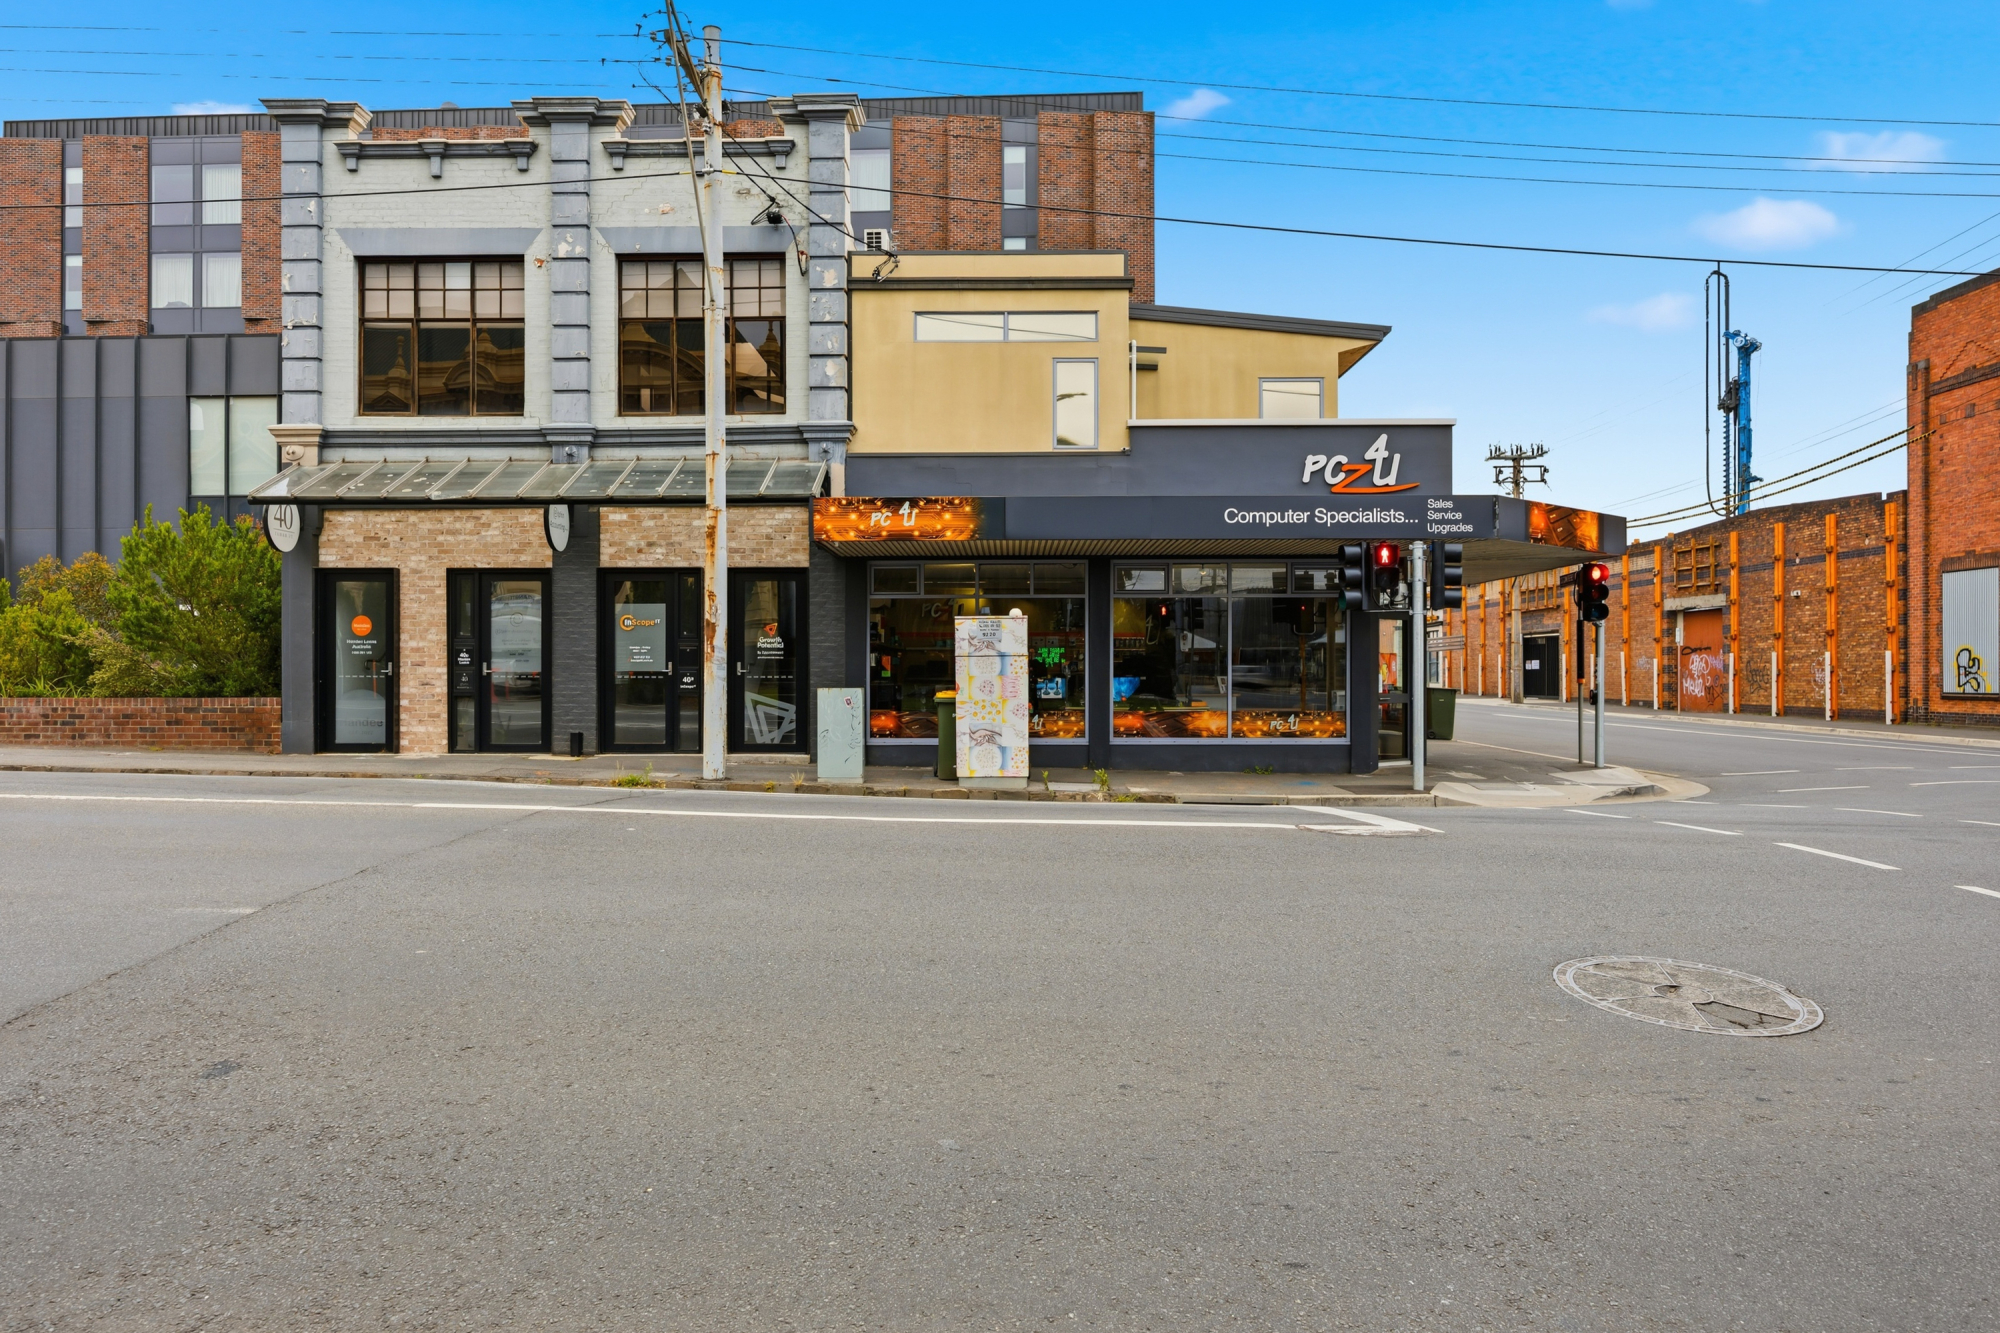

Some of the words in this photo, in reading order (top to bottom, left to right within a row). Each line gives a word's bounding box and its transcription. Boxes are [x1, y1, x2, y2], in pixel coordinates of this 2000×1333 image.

[1427, 498, 1454, 509] Sales
[273, 504, 293, 530] 40
[1224, 508, 1311, 527] Computer
[1427, 510, 1462, 520] Service
[1427, 522, 1474, 535] Upgrades
